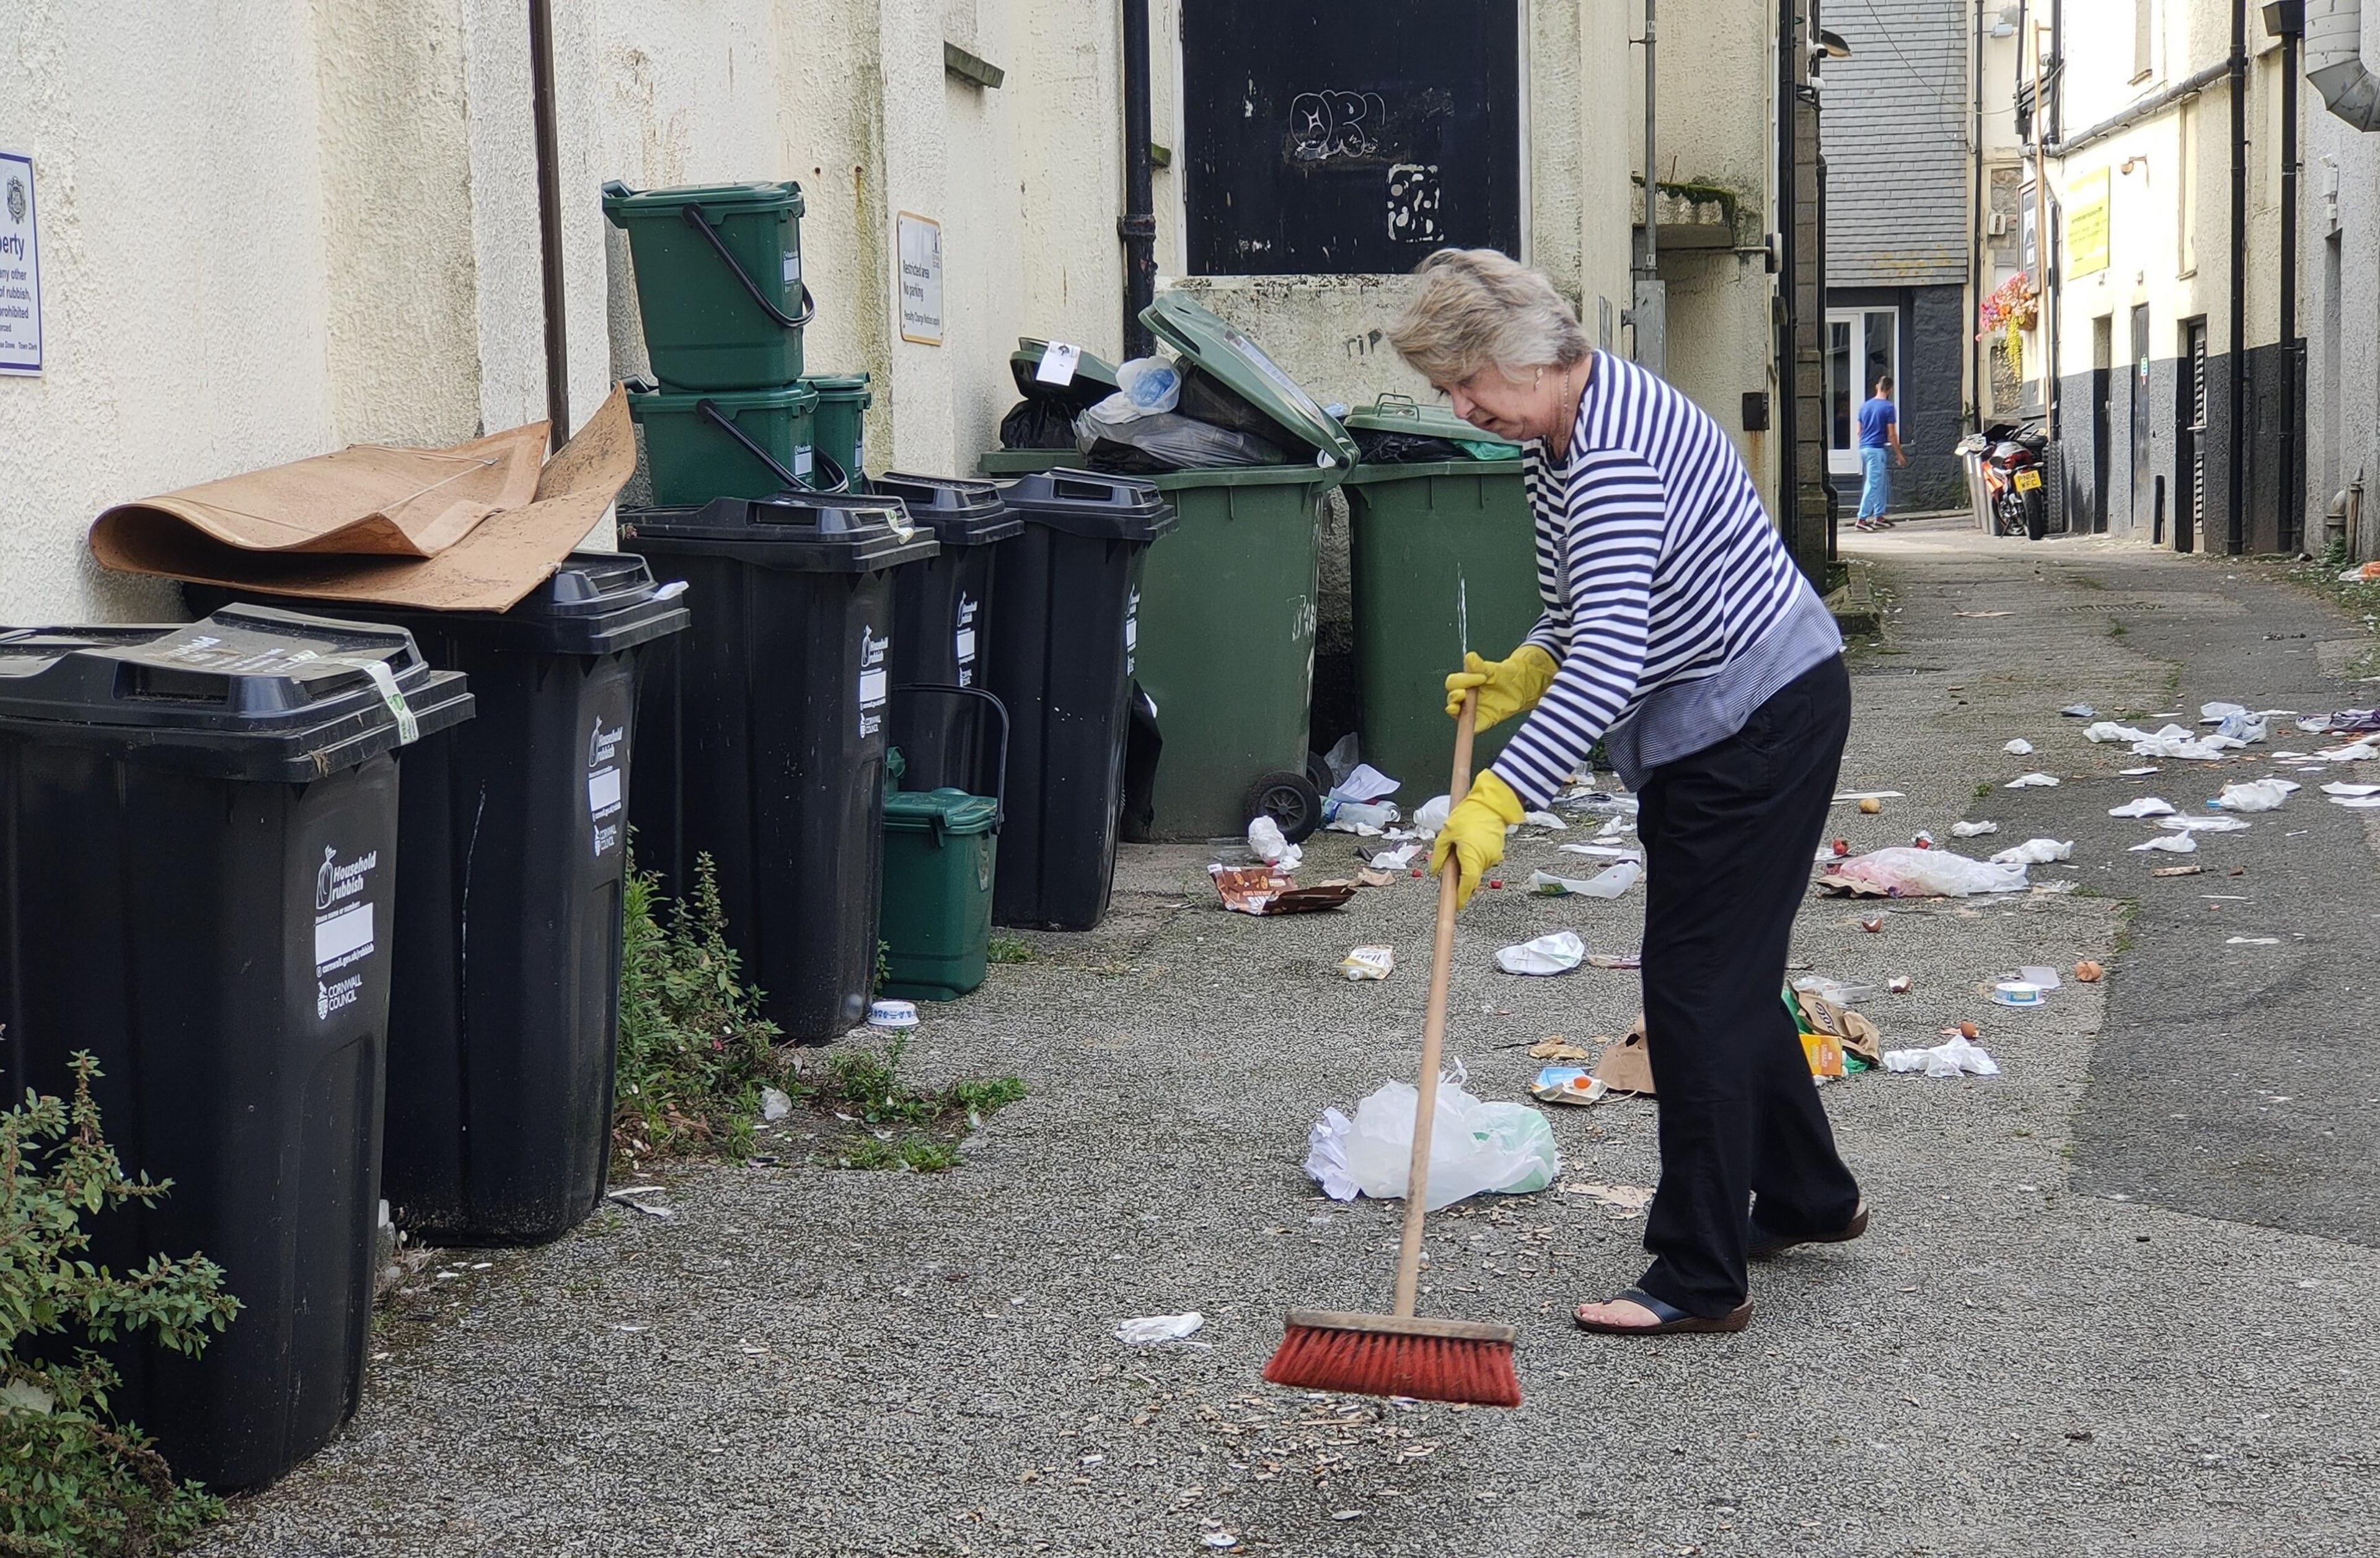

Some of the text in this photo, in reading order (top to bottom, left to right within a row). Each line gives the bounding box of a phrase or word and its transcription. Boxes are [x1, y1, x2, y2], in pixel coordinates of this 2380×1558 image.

[11, 268, 27, 280] other
[903, 259, 921, 277] Restricted
[922, 268, 930, 279] area
[6, 286, 31, 302] rubbish,
[904, 281, 923, 301] No parking
[904, 309, 914, 323] Penalty
[915, 311, 923, 325] Charge
[333, 850, 377, 883] Household
[332, 874, 364, 901] rubbish
[328, 973, 363, 998] CORNWALL
[329, 989, 357, 1011] COUNCIL
